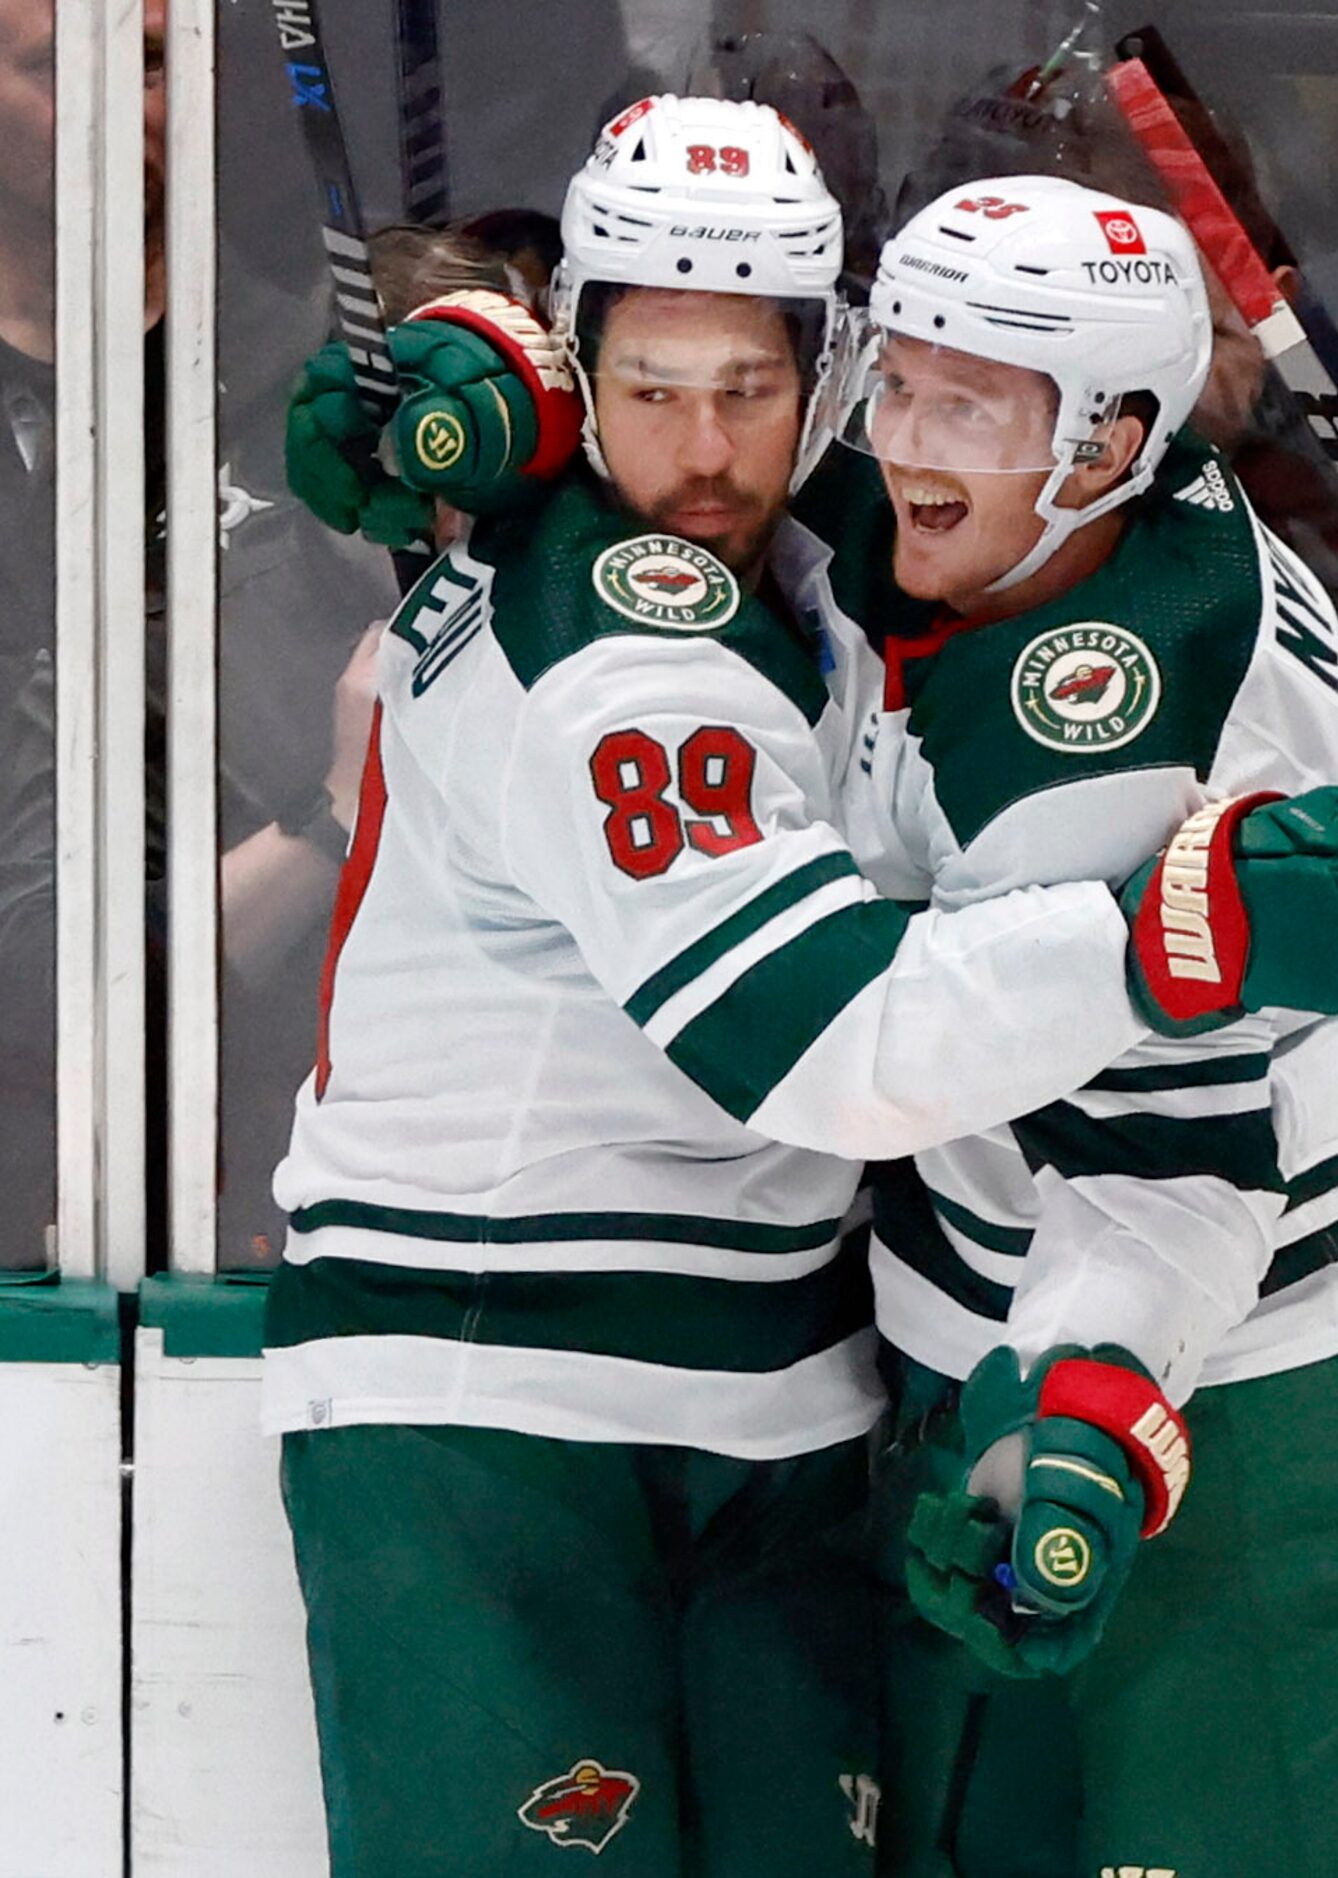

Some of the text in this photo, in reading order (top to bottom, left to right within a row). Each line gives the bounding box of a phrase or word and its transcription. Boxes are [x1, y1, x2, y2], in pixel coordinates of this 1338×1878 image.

[686, 144, 750, 178] 89
[669, 224, 763, 243] BAUER
[899, 253, 970, 284] WARRIOR
[1081, 260, 1179, 286] TOYOTA
[1202, 459, 1235, 513] adidas
[608, 540, 726, 585] MINNESOTA
[633, 598, 696, 622] WILD
[1022, 631, 1140, 688] MINNESOTA
[1063, 715, 1126, 741] WILD
[588, 725, 765, 881] 89
